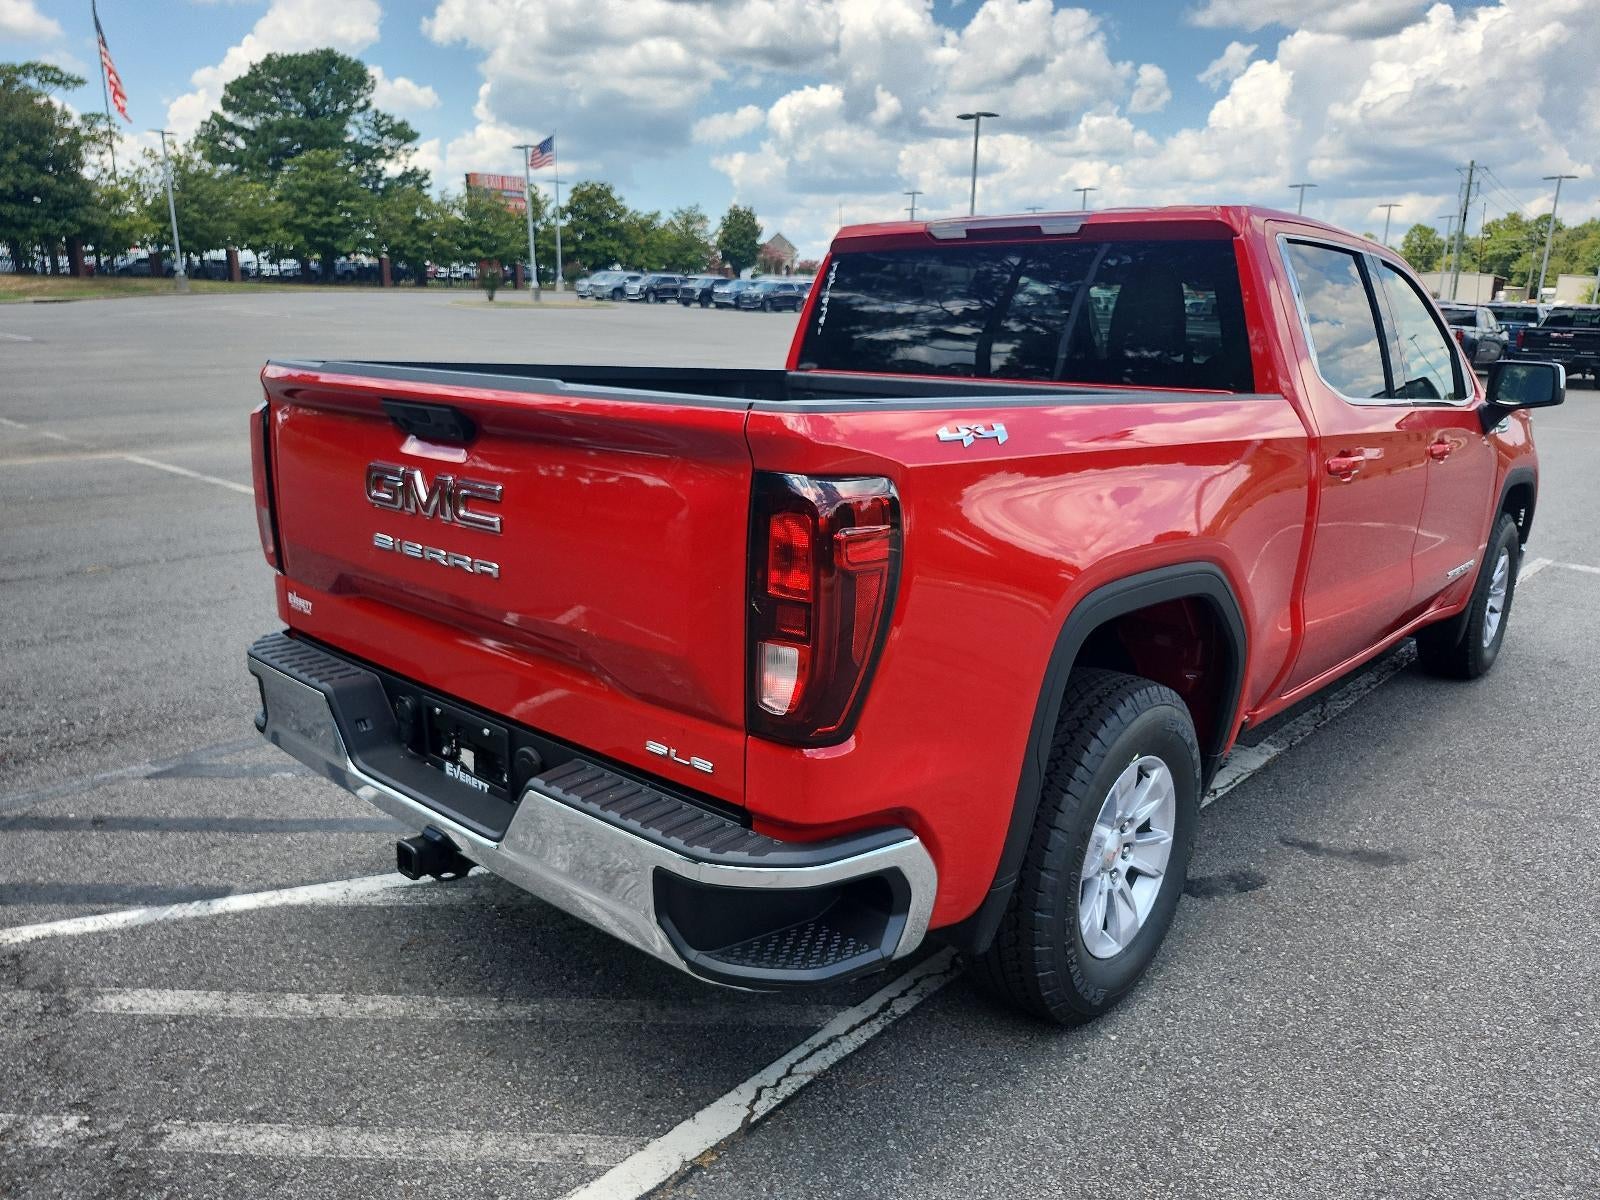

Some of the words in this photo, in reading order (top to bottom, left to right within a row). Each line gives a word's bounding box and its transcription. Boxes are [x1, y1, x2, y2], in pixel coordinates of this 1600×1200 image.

[365, 461, 504, 536] GMC
[373, 532, 500, 579] SIERRA
[445, 761, 490, 793] EVERETT
[645, 740, 714, 774] SLE
